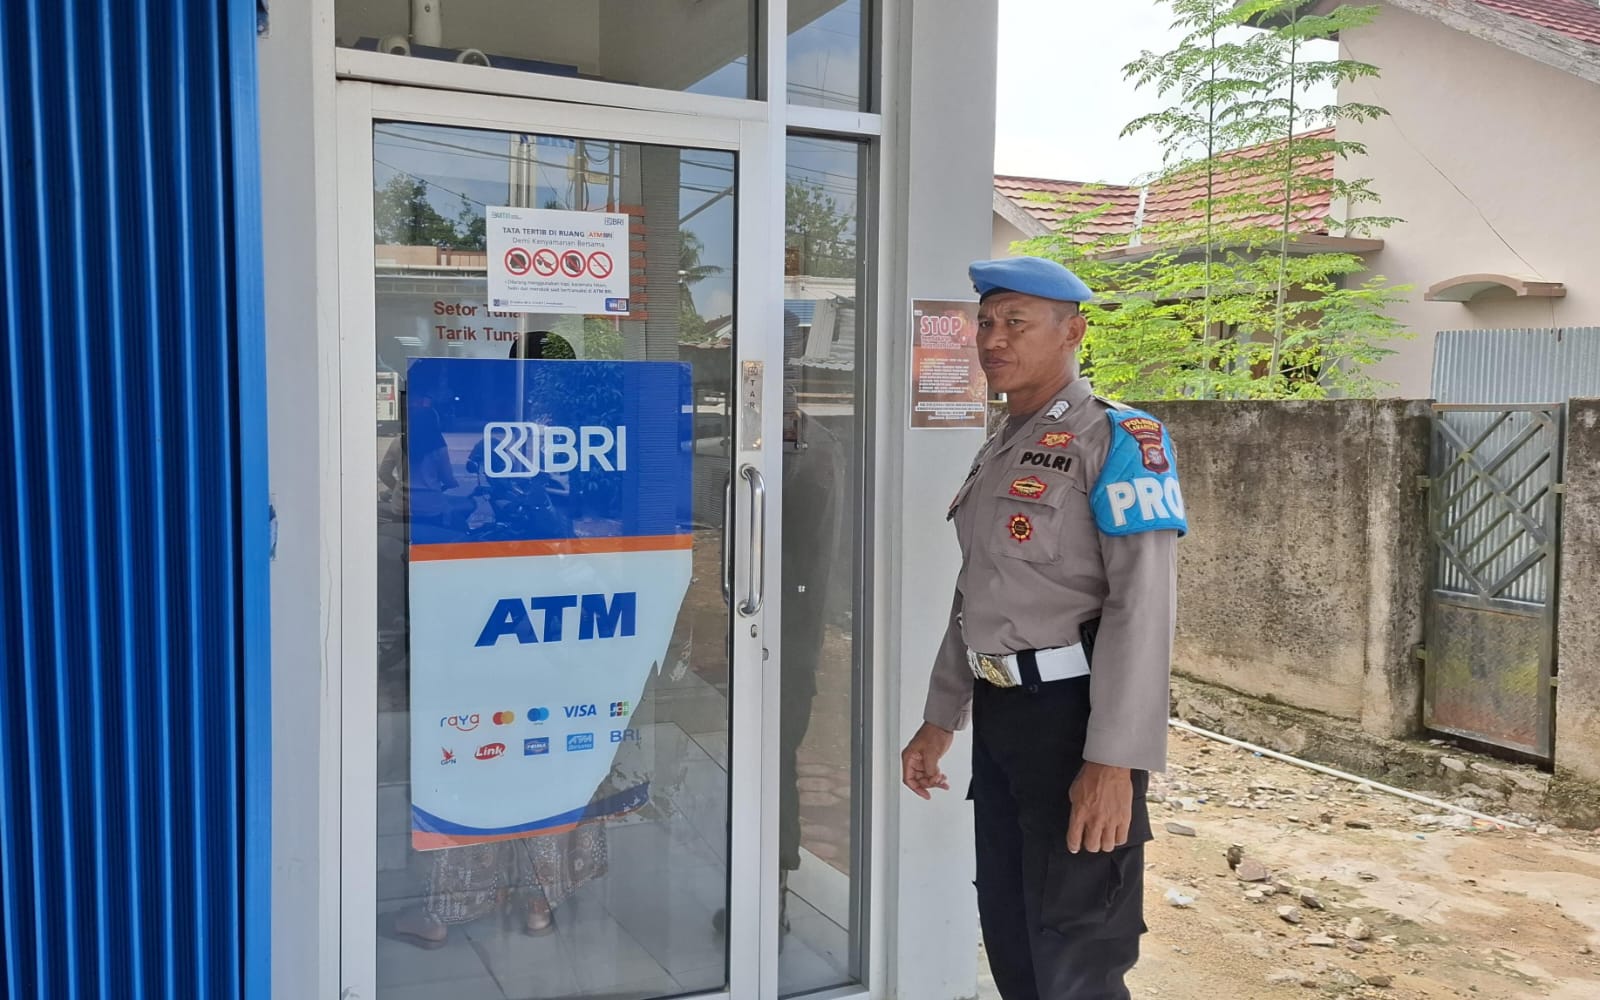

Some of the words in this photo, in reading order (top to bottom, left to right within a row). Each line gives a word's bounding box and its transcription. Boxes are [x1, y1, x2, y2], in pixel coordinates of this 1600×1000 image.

[503, 227, 520, 235] TATA
[522, 228, 547, 236] TERTIB
[532, 238, 576, 247] Kenyamanan
[577, 240, 605, 248] Bersama
[434, 300, 477, 316] Setor
[435, 325, 476, 341] Tarik
[920, 315, 963, 335] STOP
[544, 425, 626, 473] BRI
[1020, 451, 1072, 472] POLRI
[1106, 477, 1184, 527] PRO
[474, 592, 636, 647] ATM
[563, 704, 597, 718] VISA
[610, 701, 629, 717] JCB
[476, 745, 505, 758] Link
